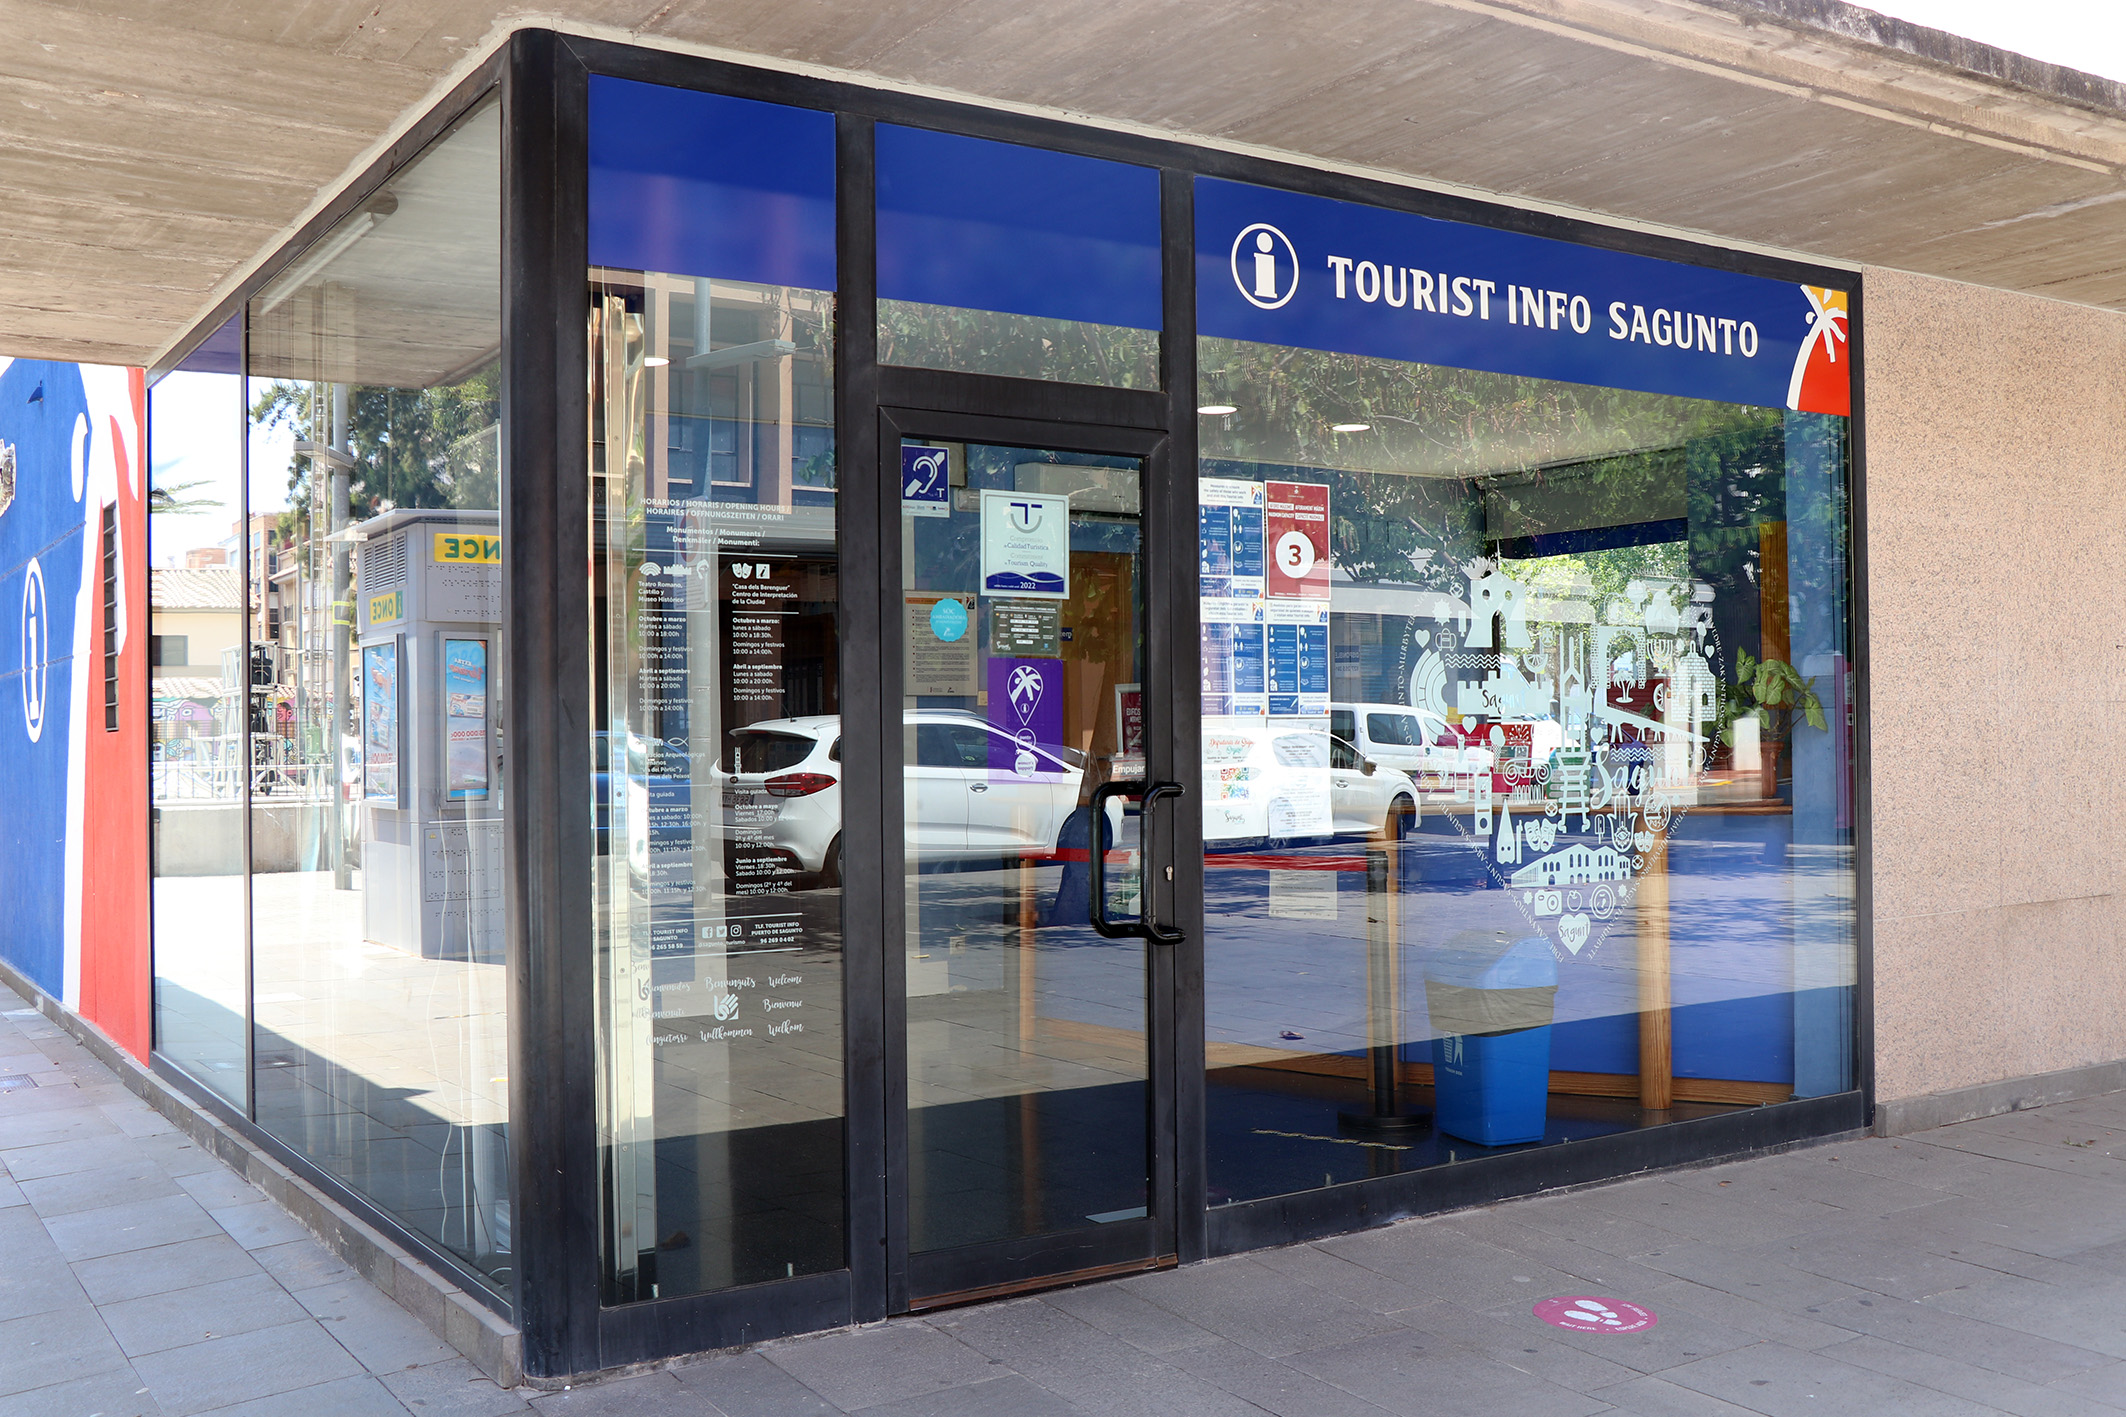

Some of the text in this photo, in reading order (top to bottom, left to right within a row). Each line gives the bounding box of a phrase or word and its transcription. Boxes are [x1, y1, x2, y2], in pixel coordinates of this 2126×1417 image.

[1328, 254, 1759, 358] TOURIST INFO SAGUNTO
[640, 498, 786, 512] HORARIOS HORARIS OPENING HOURS
[647, 508, 684, 516] HORAIRES
[667, 526, 761, 537] Monumentos Monuments
[718, 538, 760, 546] Monumenti:
[1288, 544, 1302, 566] 3
[1113, 764, 1145, 775] Empujar
[768, 974, 802, 988] Welcome
[762, 998, 803, 1012] Bienvenue
[700, 1019, 804, 1042] Willkommen Welkom
